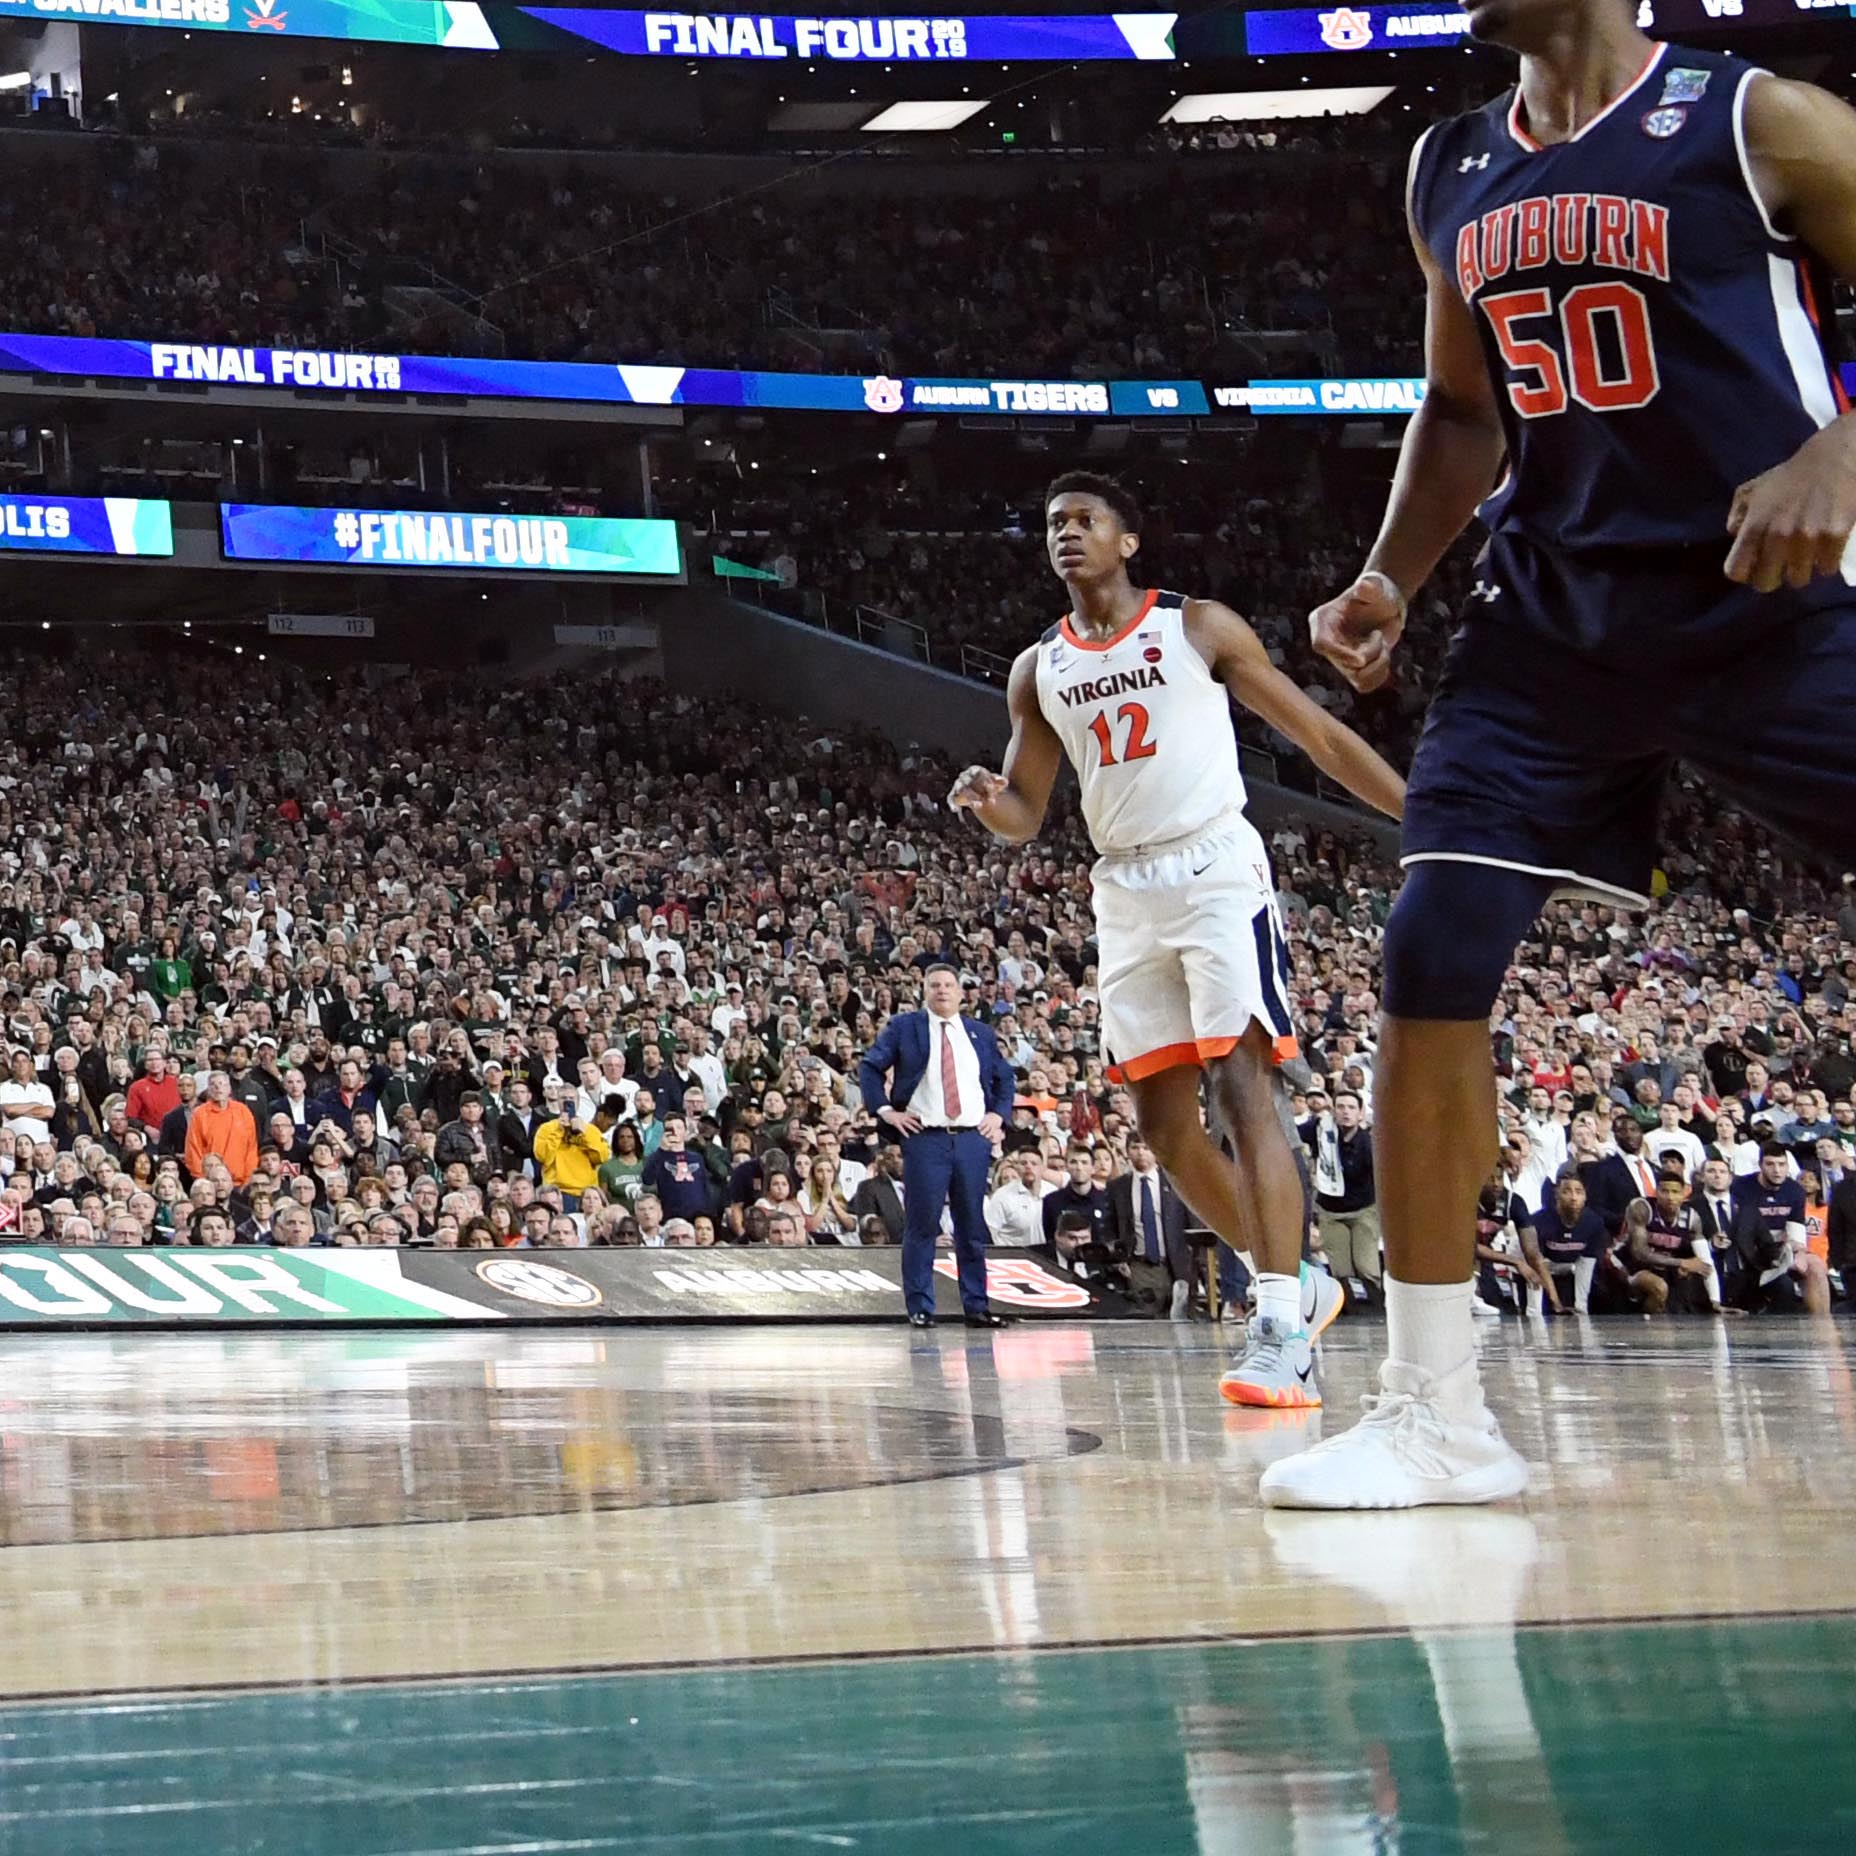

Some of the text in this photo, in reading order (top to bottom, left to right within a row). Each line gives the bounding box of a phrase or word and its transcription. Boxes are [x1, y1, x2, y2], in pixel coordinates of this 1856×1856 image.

[643, 14, 788, 58] FINAL
[794, 18, 930, 58] FOUR
[1456, 193, 1671, 304] AUBURN
[151, 344, 265, 384] FINAL
[271, 349, 374, 389] FOUR
[1478, 280, 1662, 419] 50
[913, 383, 989, 407] AUBURN
[990, 382, 1109, 412] TIGERS
[1146, 387, 1178, 408] VS
[1216, 385, 1316, 408] VIRGINIA
[334, 512, 571, 565] #FINALFOUR
[273, 617, 366, 634] 112 113
[597, 629, 616, 642] 113
[1056, 665, 1168, 708] VIRGINIA
[1088, 701, 1157, 768] 12
[652, 1268, 903, 1293] AUBURN
